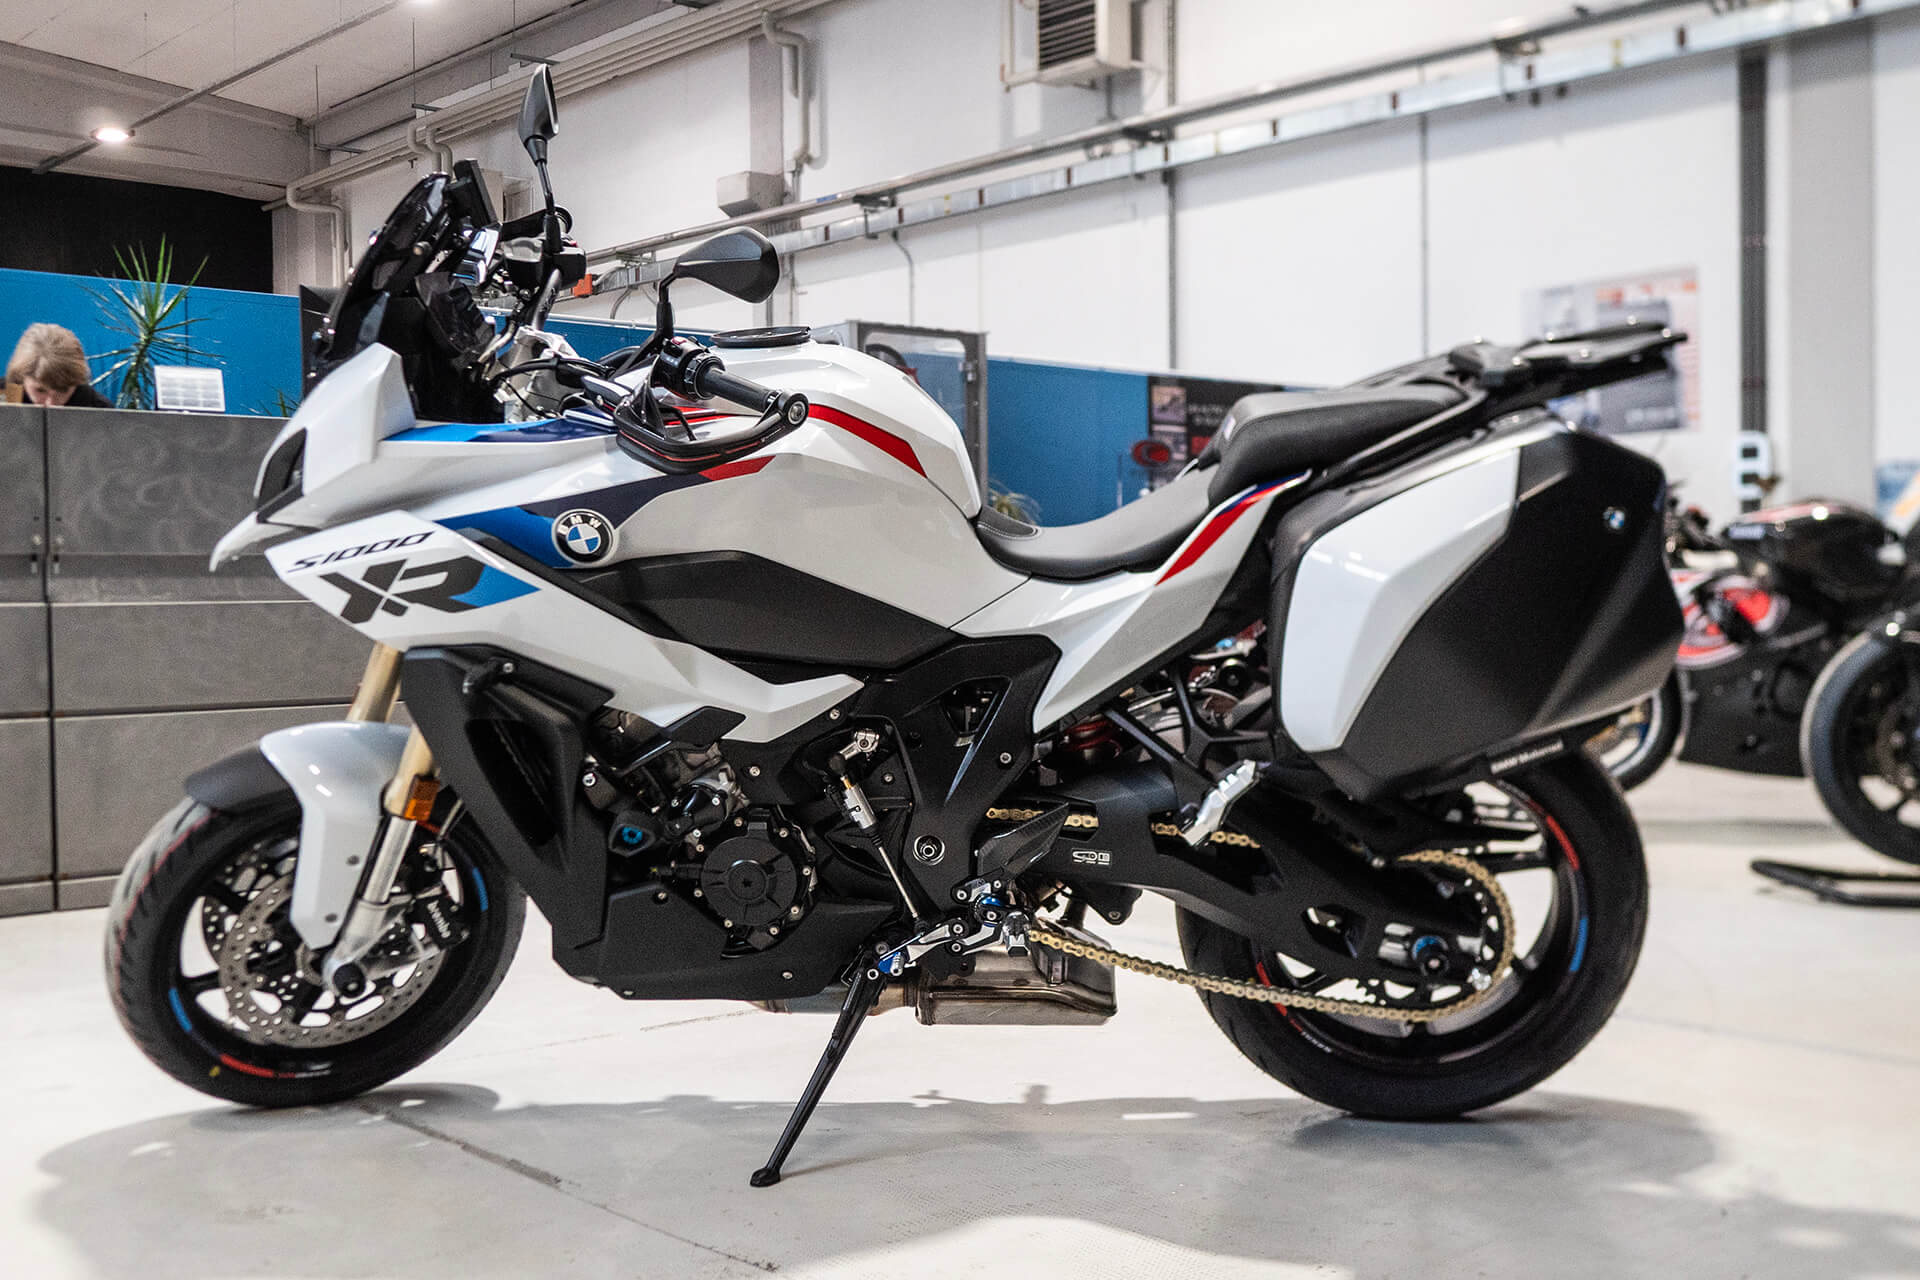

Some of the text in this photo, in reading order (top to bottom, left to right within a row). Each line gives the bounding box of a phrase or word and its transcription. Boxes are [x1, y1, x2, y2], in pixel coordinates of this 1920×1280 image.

[557, 514, 602, 536] BMW
[318, 555, 487, 624] XR
[427, 899, 451, 938] brembo
